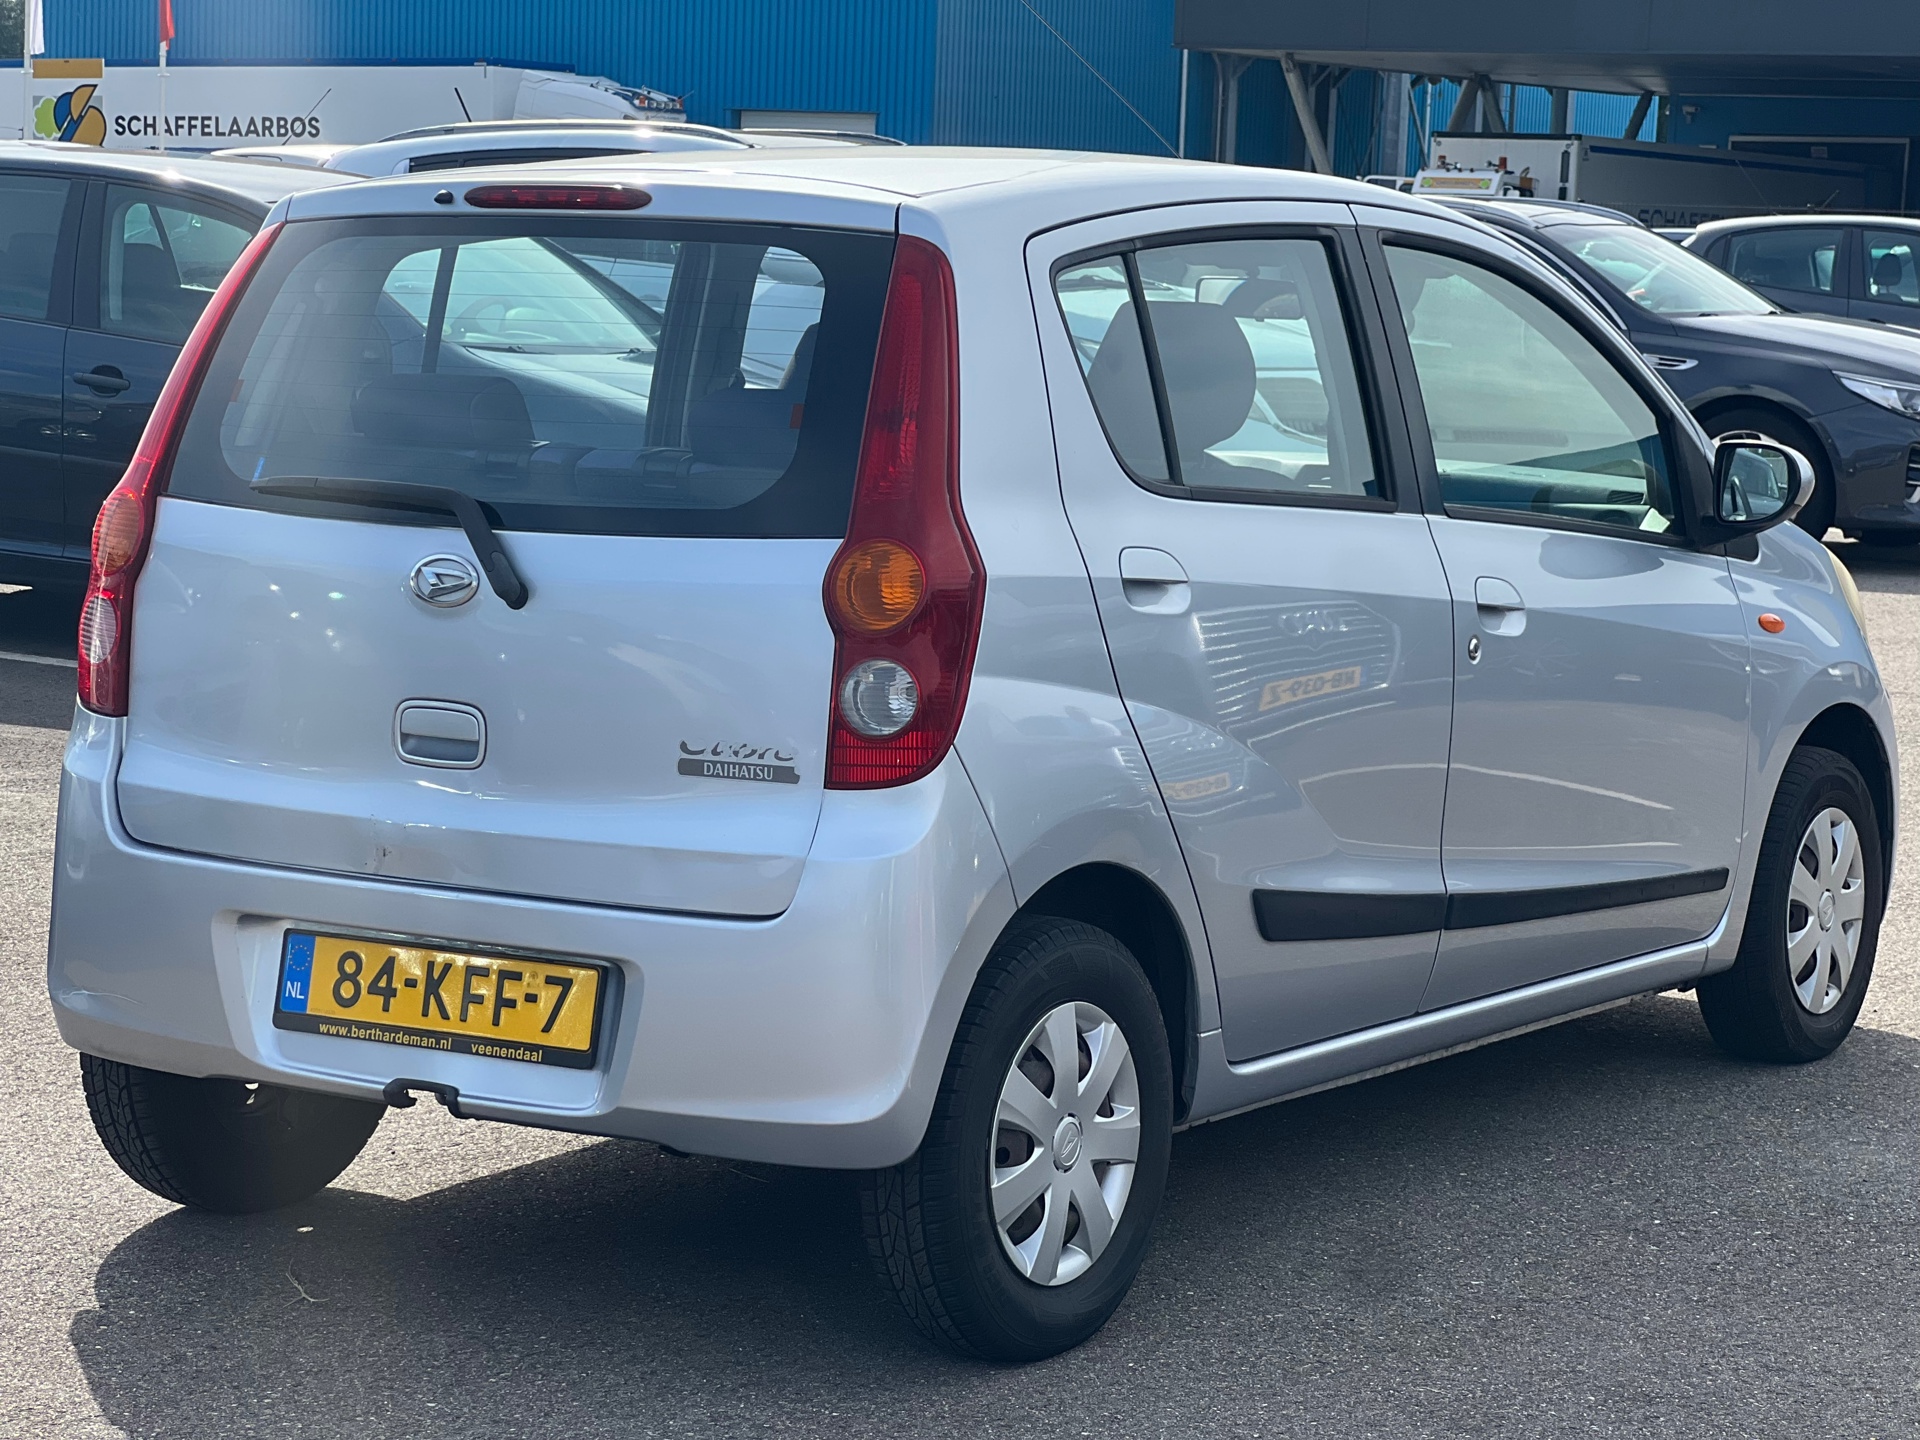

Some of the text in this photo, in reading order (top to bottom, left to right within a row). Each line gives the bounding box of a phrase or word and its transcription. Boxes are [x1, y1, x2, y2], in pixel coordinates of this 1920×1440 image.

[114, 115, 320, 138] SCHAFFELAARBOS
[703, 762, 774, 780] DAIHATSU
[285, 980, 305, 999] NL
[332, 950, 574, 1033] 84-KFF-7
[319, 1023, 543, 1063] www.berthardeman.nl veenendaal
